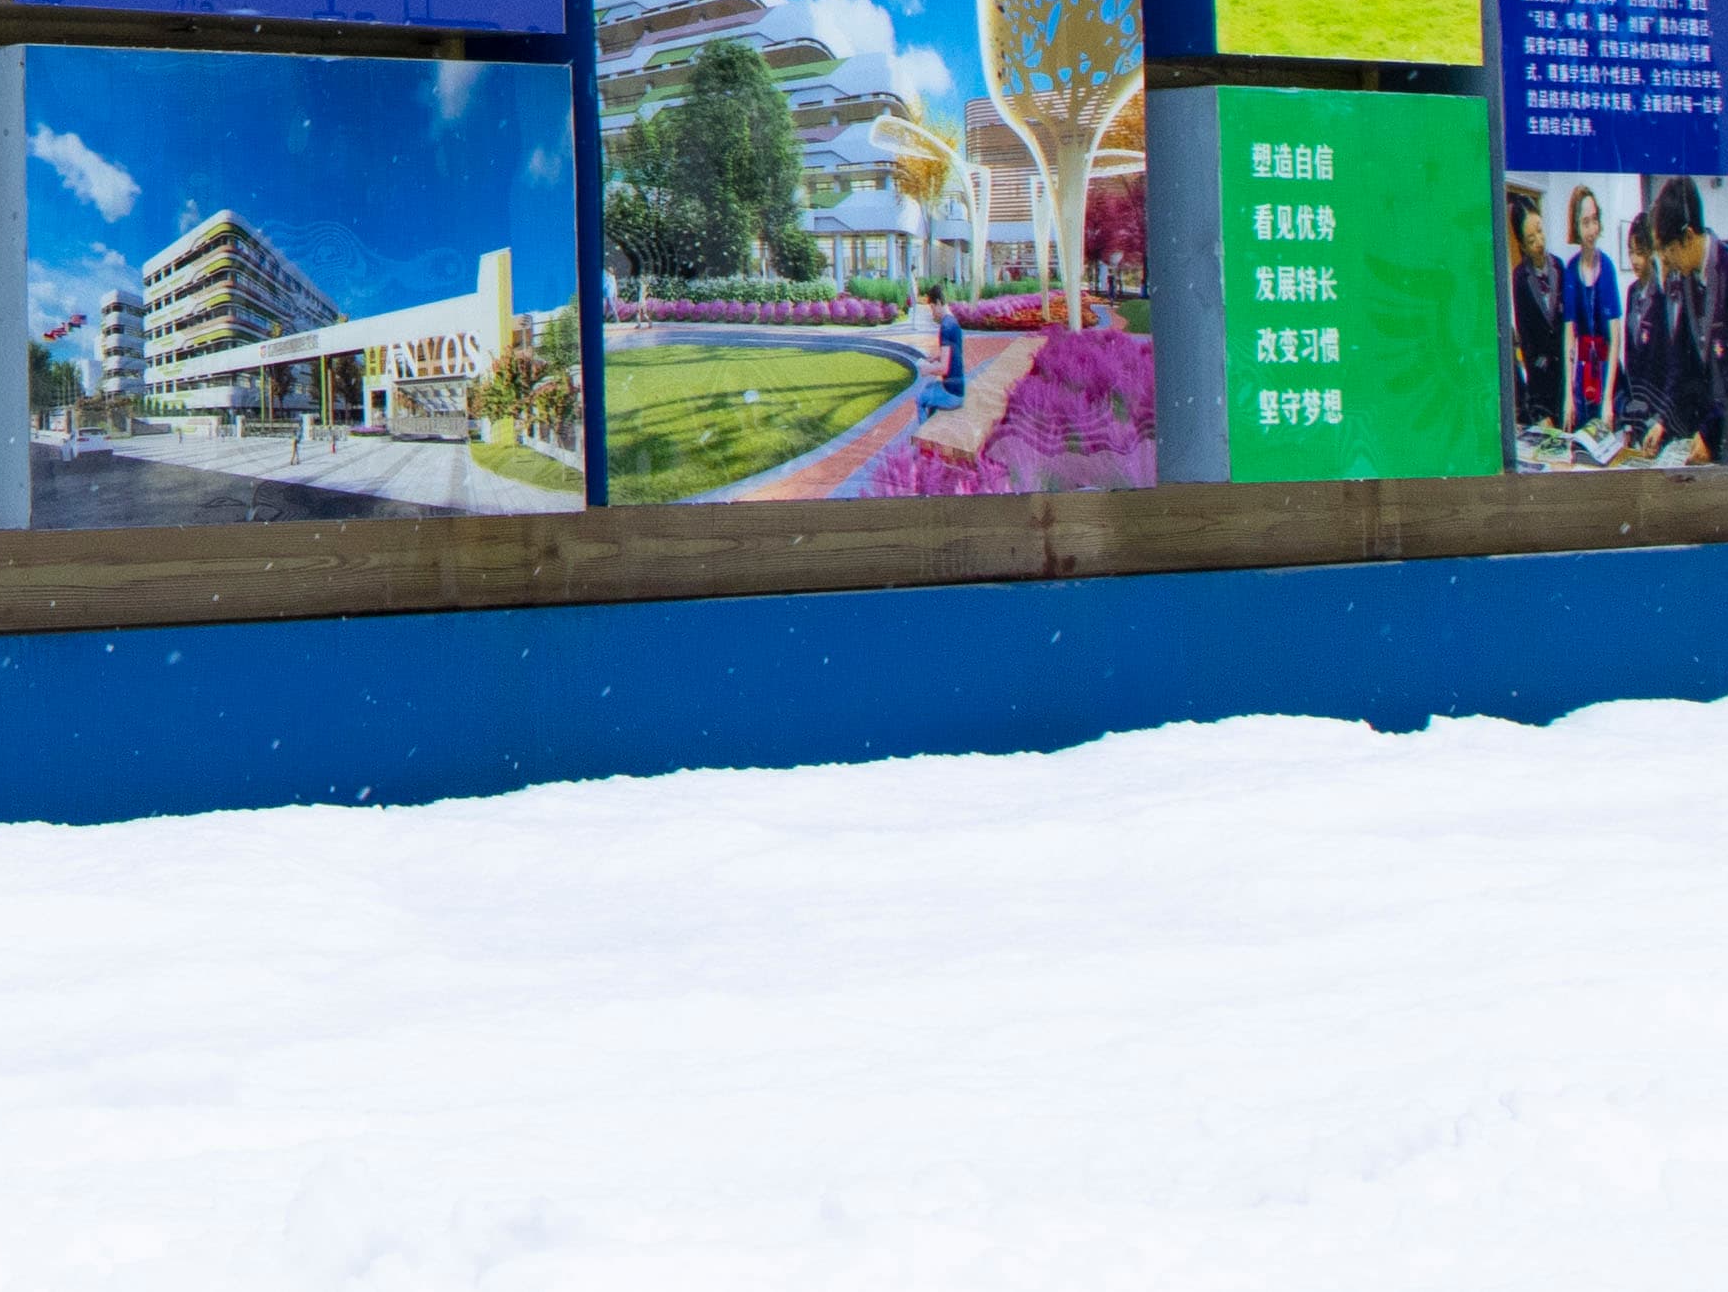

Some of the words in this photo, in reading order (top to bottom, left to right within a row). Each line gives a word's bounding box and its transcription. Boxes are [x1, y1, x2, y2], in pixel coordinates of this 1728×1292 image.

[1251, 142, 1335, 181] 塑造自信
[1252, 203, 1336, 242] 看见优势
[1255, 265, 1338, 302] 发展特长
[1256, 327, 1340, 364] 改变习惯
[1258, 388, 1343, 426] 坚守梦想
